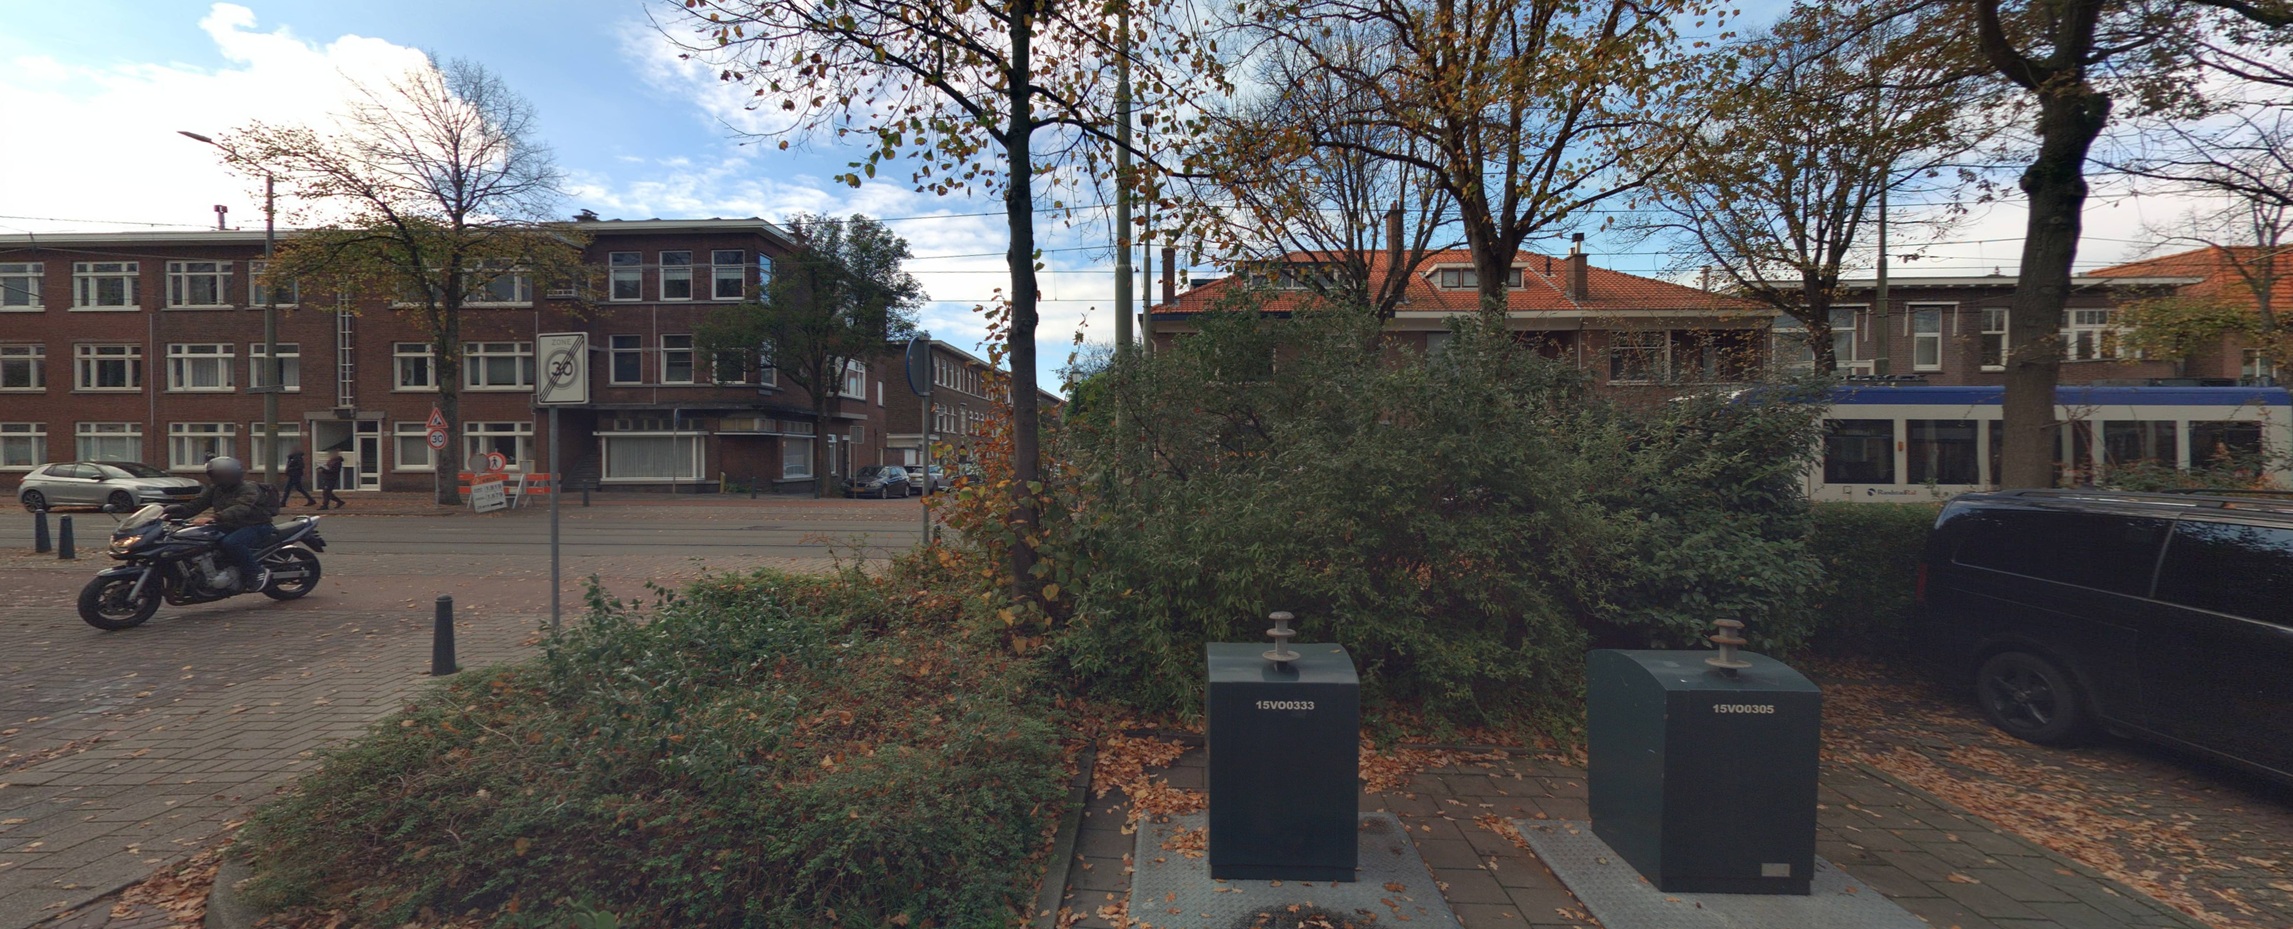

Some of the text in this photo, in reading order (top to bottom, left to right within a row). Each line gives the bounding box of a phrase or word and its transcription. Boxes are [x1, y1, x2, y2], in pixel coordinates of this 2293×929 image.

[551, 338, 572, 346] ZONE
[551, 361, 573, 376] 30
[432, 434, 444, 444] 30
